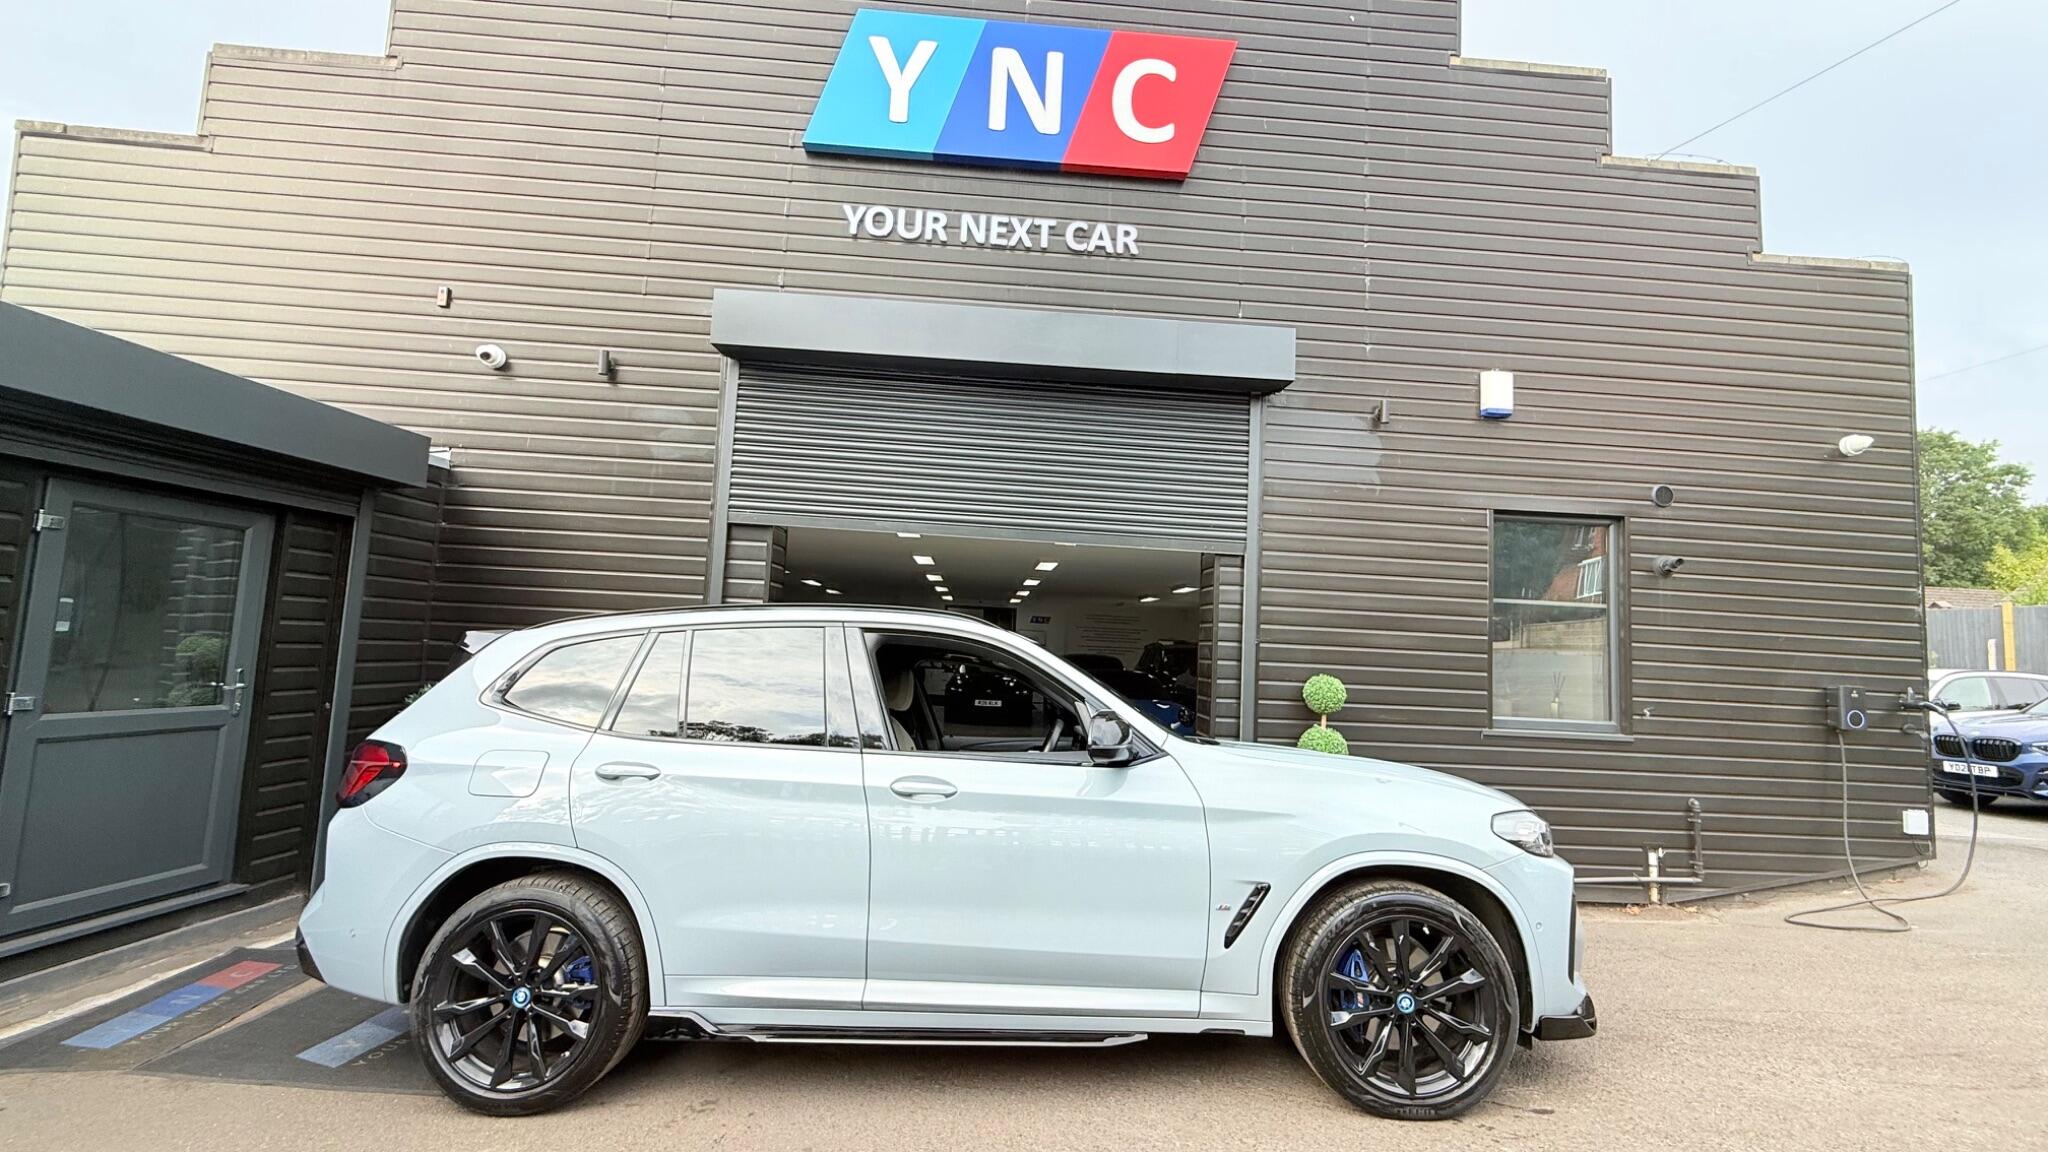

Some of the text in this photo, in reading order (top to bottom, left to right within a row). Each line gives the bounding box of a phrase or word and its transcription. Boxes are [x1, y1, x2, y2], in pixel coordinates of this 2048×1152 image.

[868, 35, 1178, 144] YNC
[843, 203, 1141, 257] YOUR NEXT CAR
[1948, 762, 1970, 773] YD2
